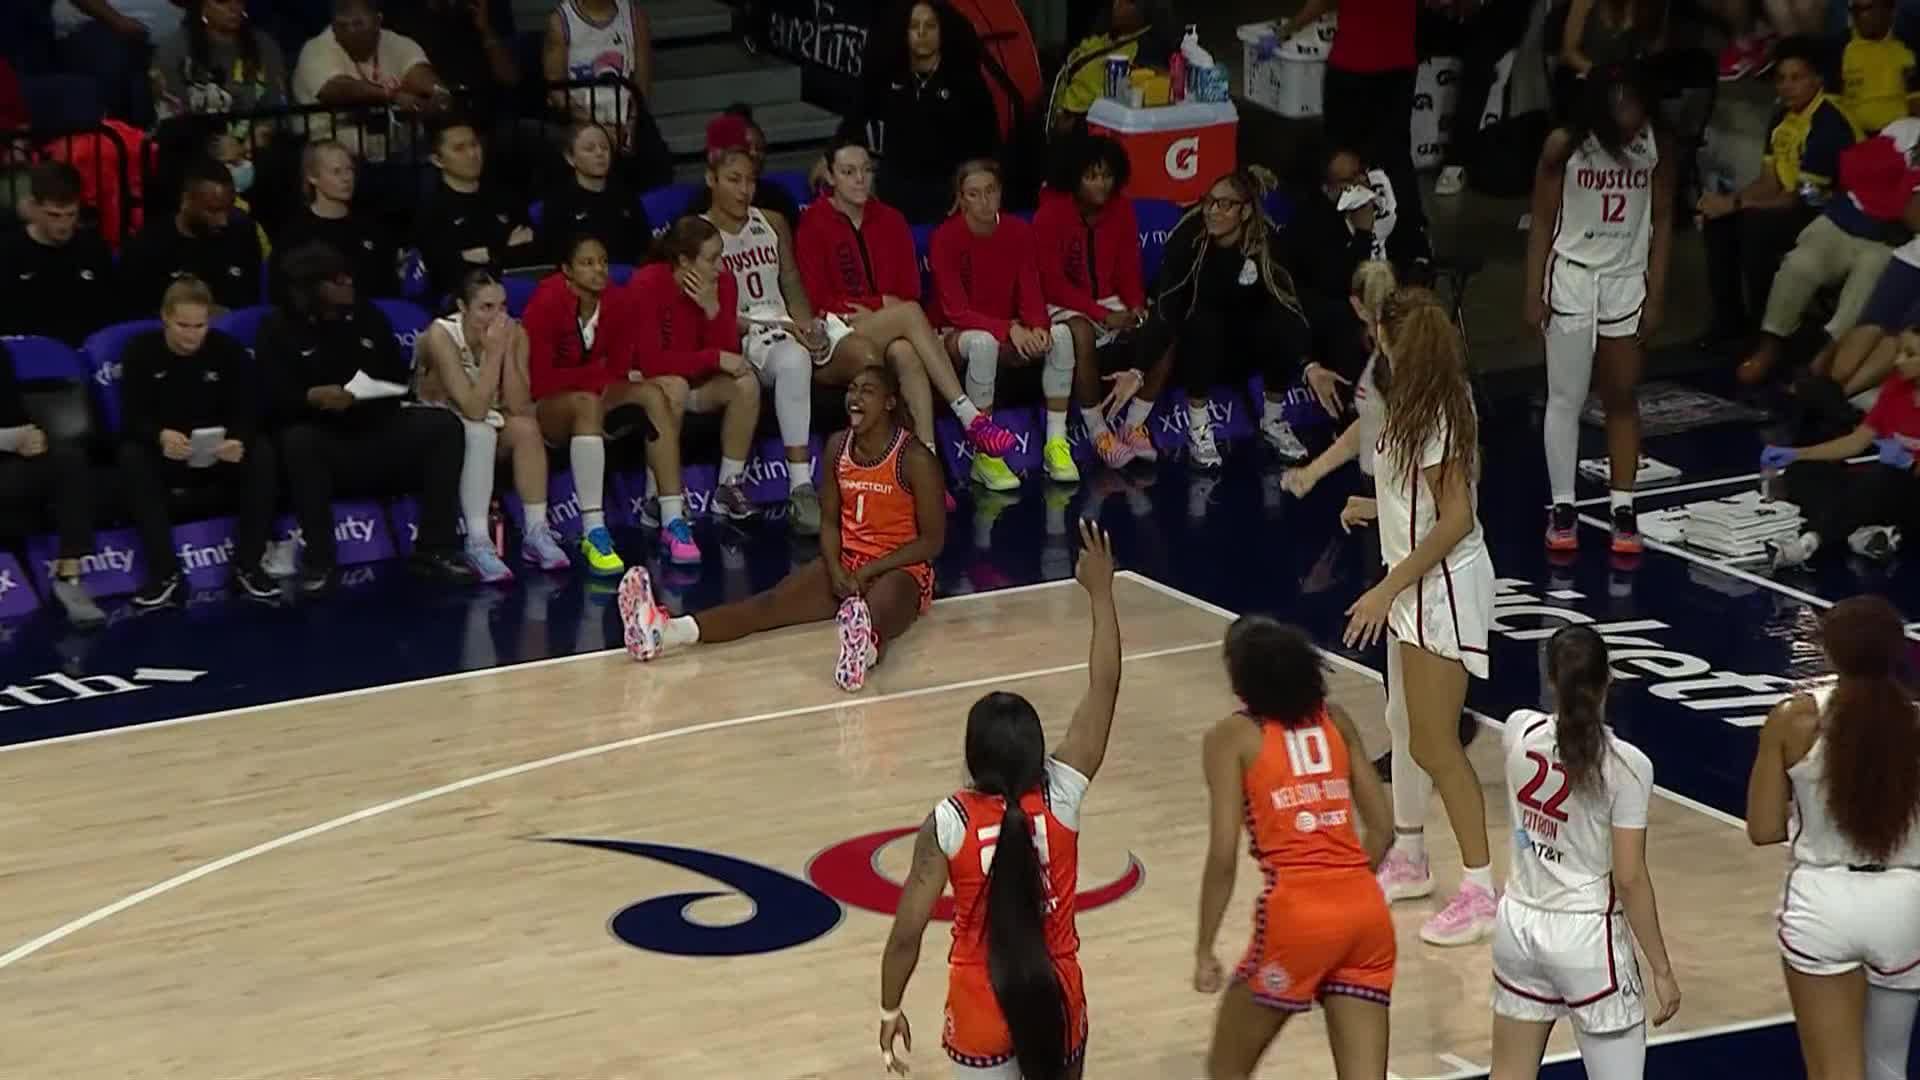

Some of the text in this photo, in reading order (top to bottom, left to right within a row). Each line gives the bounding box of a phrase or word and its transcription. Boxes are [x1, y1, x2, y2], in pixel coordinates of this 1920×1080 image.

[1577, 168, 1649, 191] mystics
[1601, 193, 1627, 224] 12
[745, 270, 764, 300] 0
[1158, 399, 1233, 435] xfity
[856, 493, 865, 525] 1
[1283, 726, 1333, 777] 10
[1516, 750, 1569, 823] 22
[1521, 808, 1559, 842] CITRON
